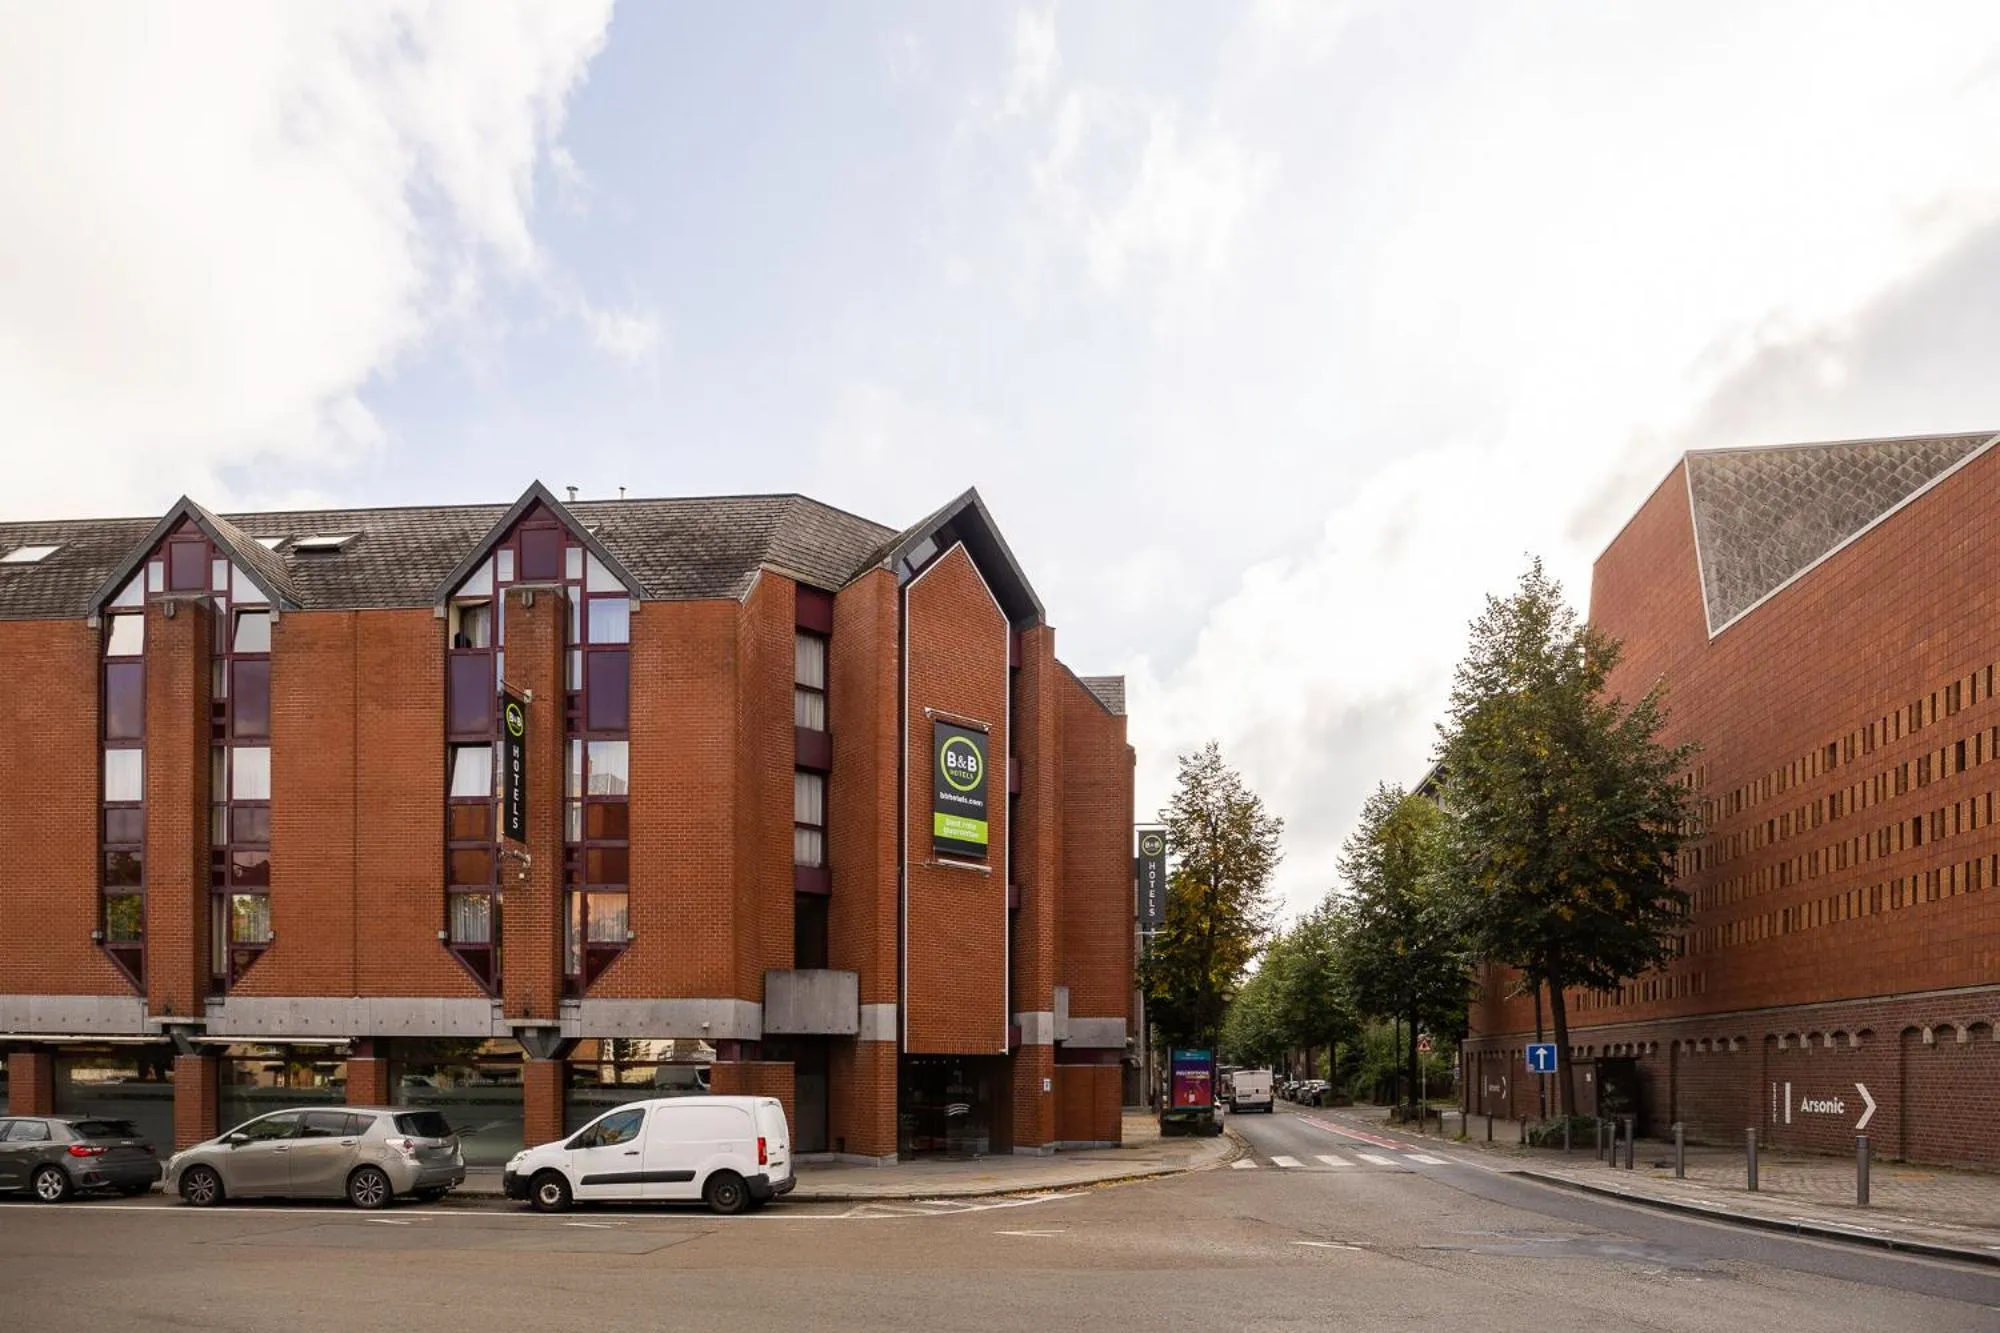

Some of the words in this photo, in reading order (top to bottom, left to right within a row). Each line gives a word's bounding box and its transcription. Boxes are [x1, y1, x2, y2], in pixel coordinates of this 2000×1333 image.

[946, 751, 977, 772] B&B
[949, 769, 975, 780] HOTELS
[512, 744, 521, 830] HOTELS
[939, 791, 983, 807] bbhotels.com
[1148, 861, 1156, 917] HOTELS
[1800, 1096, 1845, 1114] Arsonic
